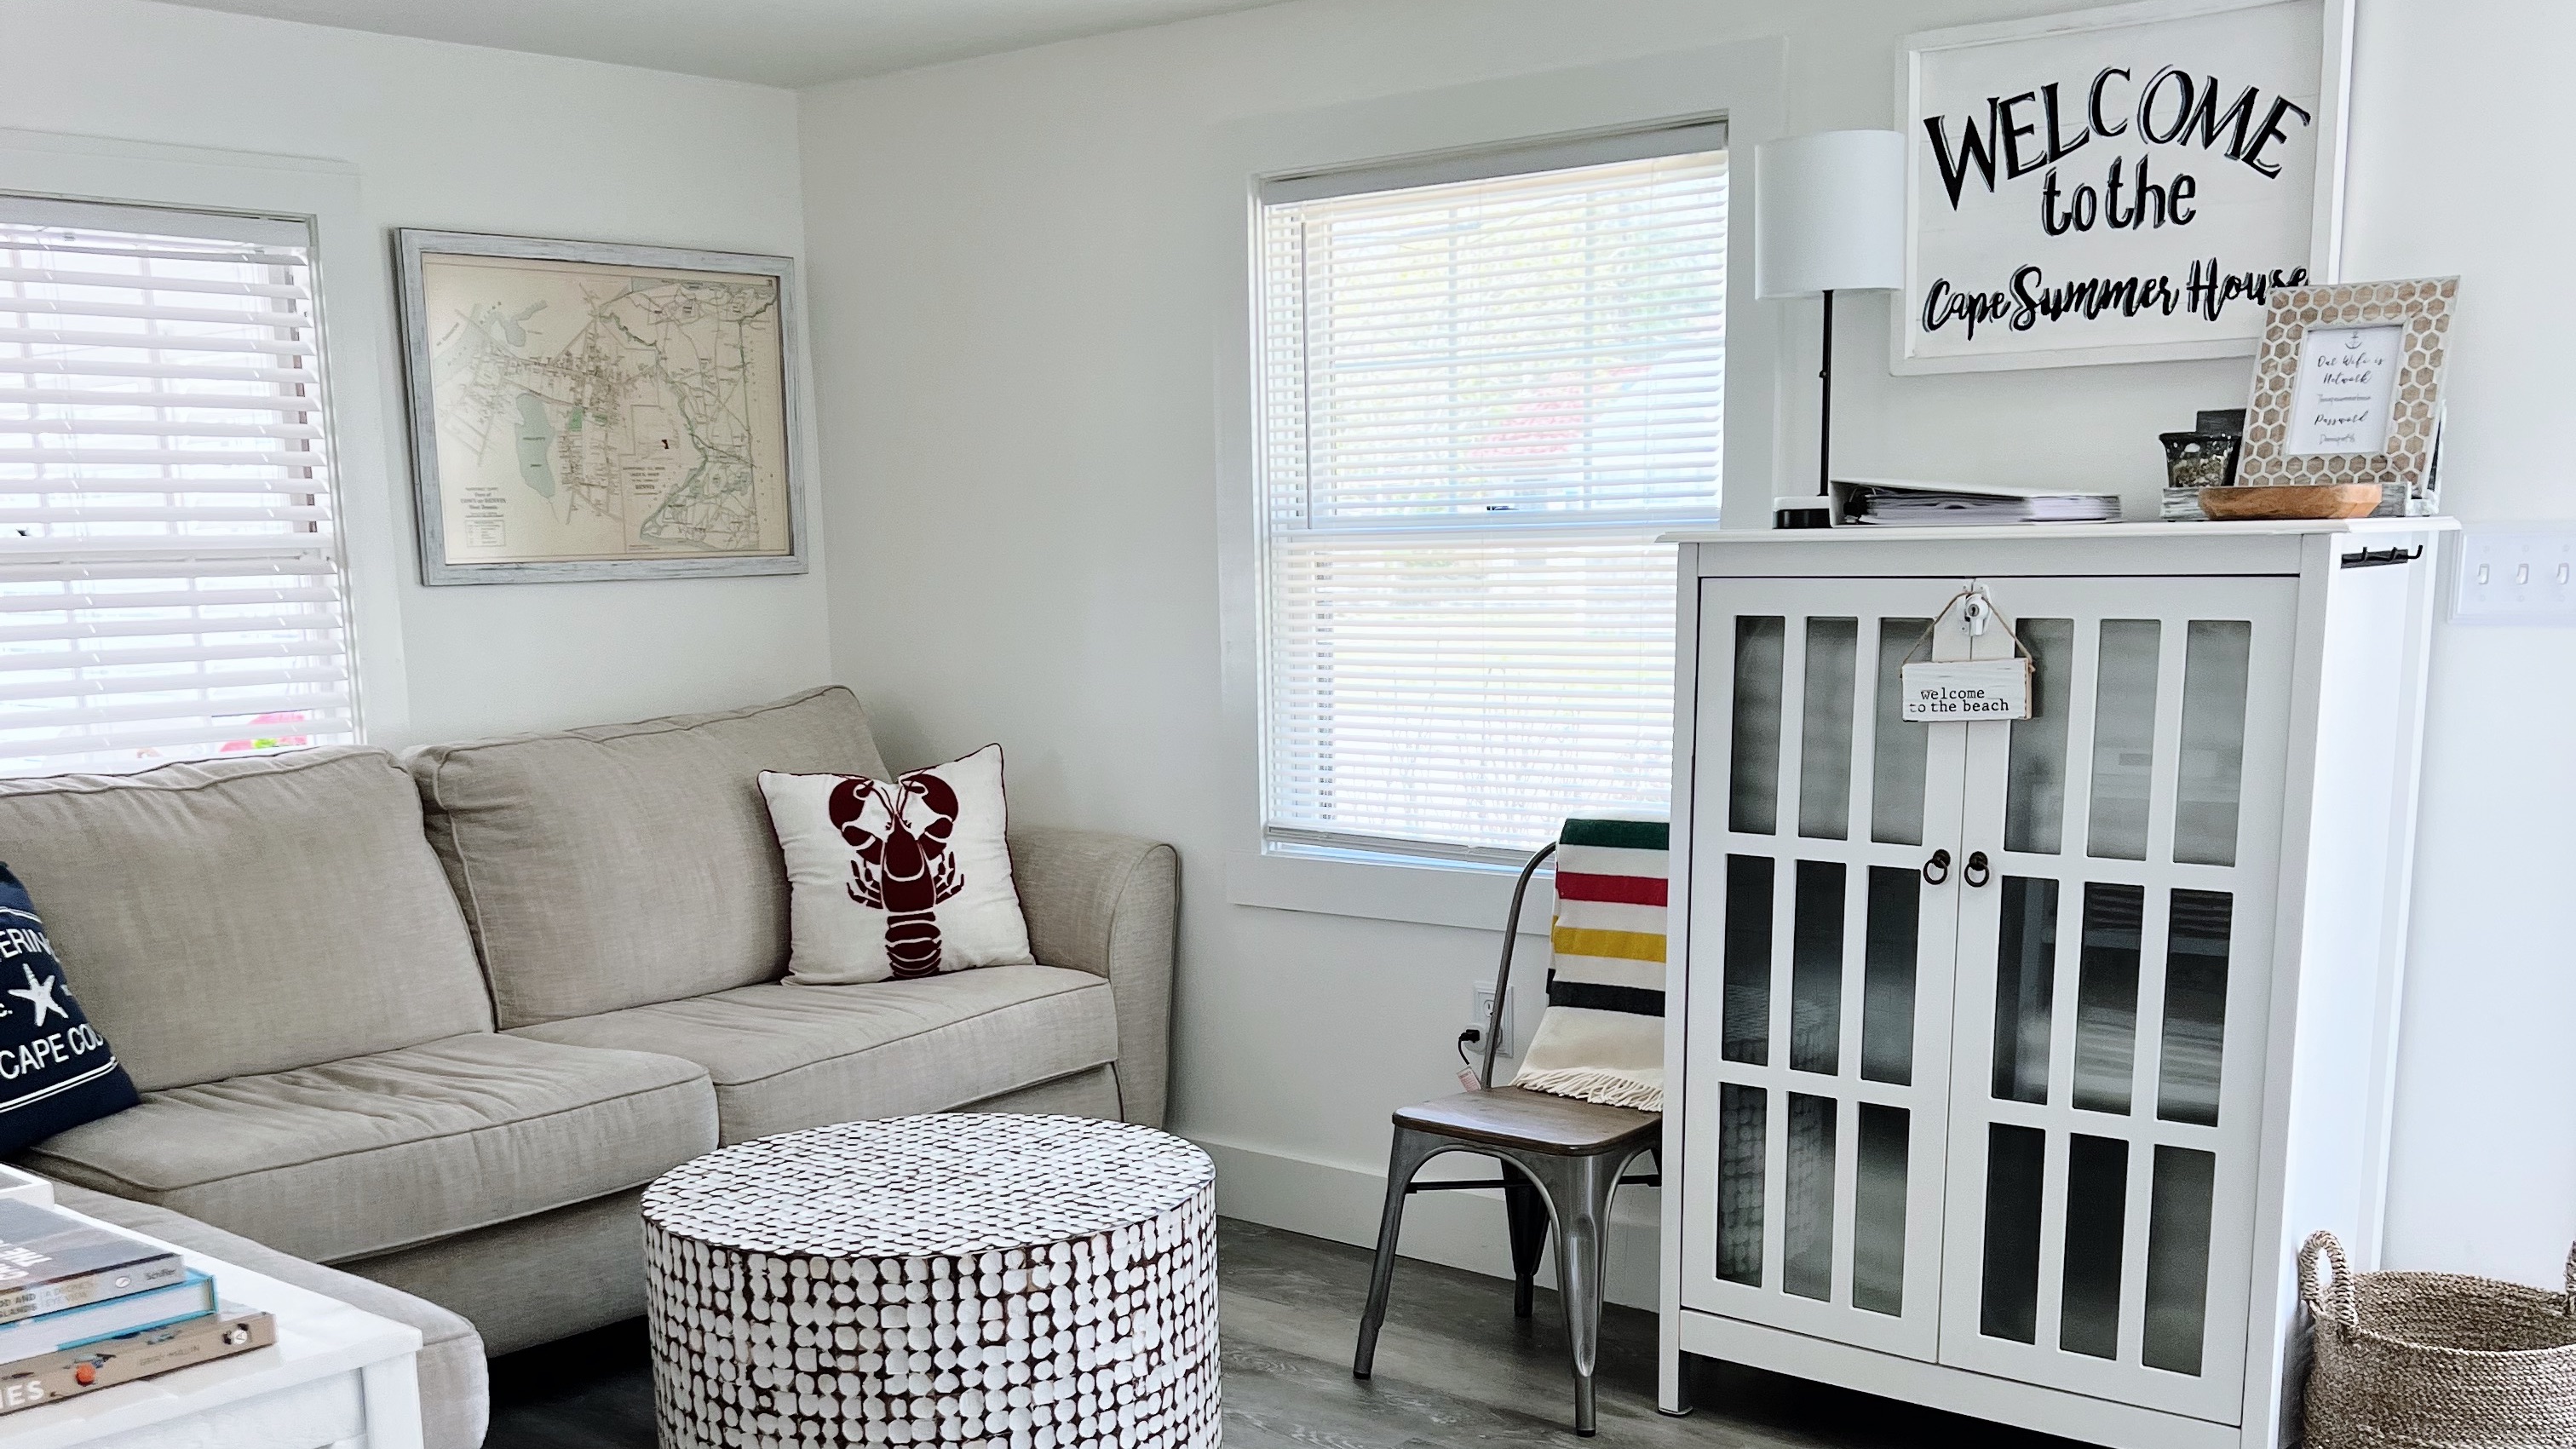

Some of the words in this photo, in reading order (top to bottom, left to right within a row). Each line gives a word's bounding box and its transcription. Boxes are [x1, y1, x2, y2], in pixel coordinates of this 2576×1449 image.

[1923, 64, 2311, 211] WELCOME
[1923, 278, 2010, 341] Cape
[2009, 264, 2180, 332] Summer
[2314, 410, 2369, 426] Password
[1909, 703, 1926, 713] to
[1930, 700, 1957, 712] the
[1963, 699, 2010, 712] beach
[1920, 687, 1985, 699] welcome
[0, 1032, 70, 1079] CAPE
